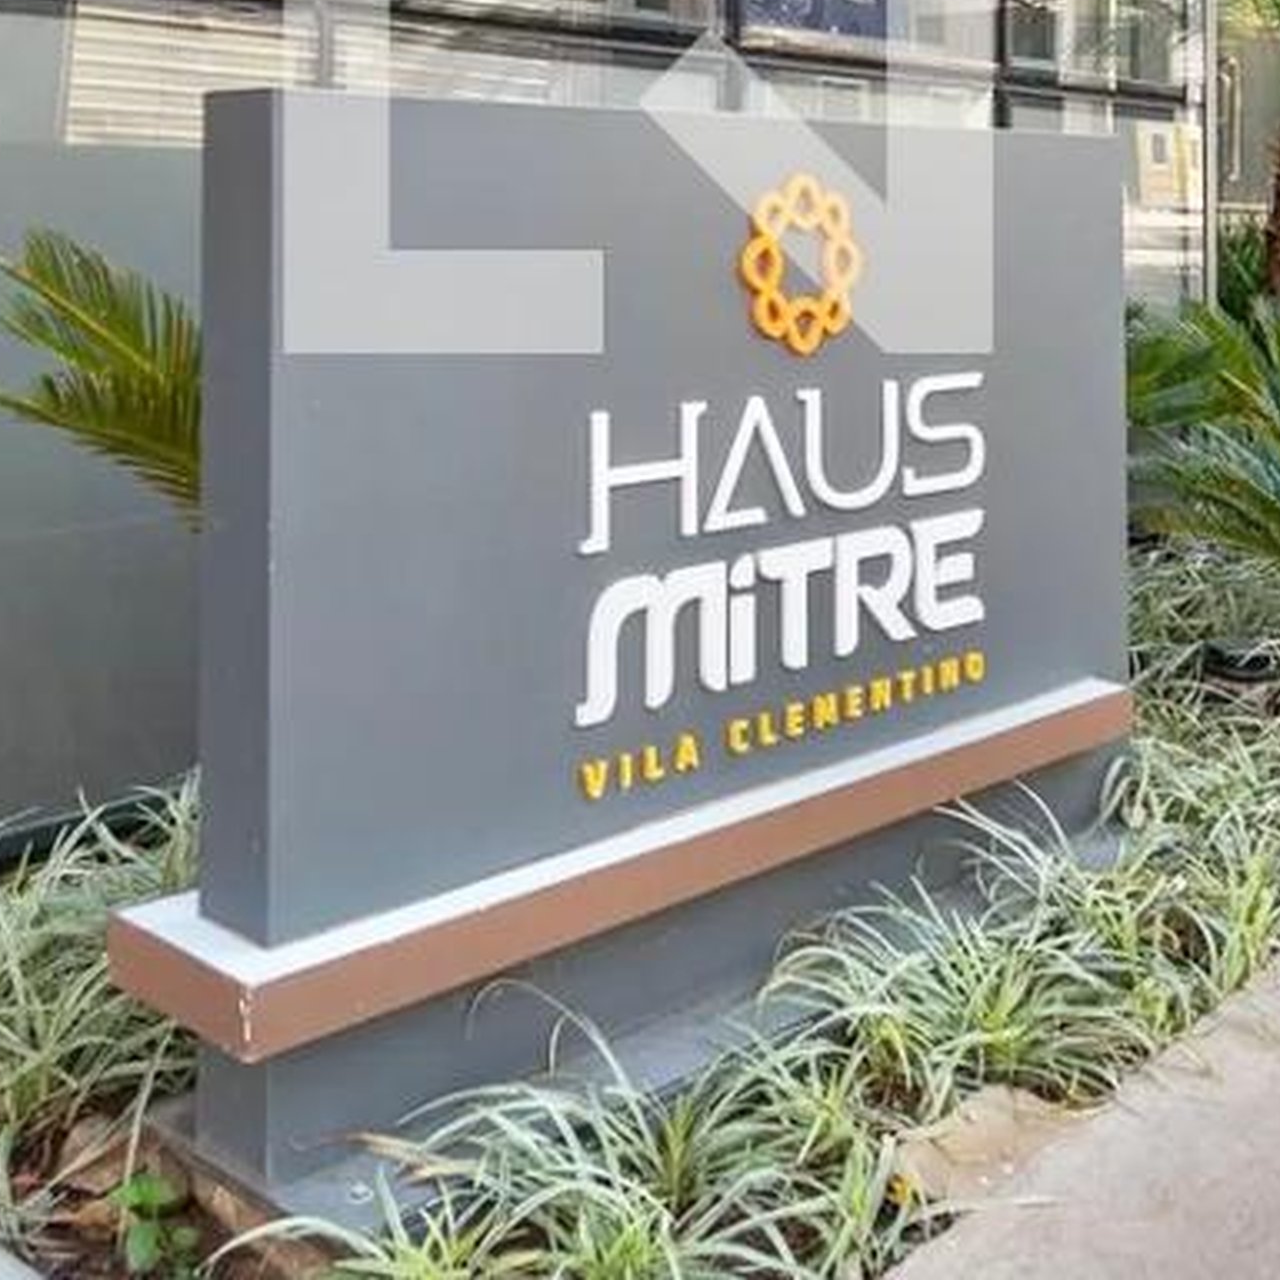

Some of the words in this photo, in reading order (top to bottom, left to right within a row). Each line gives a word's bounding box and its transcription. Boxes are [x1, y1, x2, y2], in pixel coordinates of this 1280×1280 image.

[578, 371, 987, 555] HAUS
[580, 733, 701, 800] VILA
[726, 650, 987, 754] CLEMENTINO
